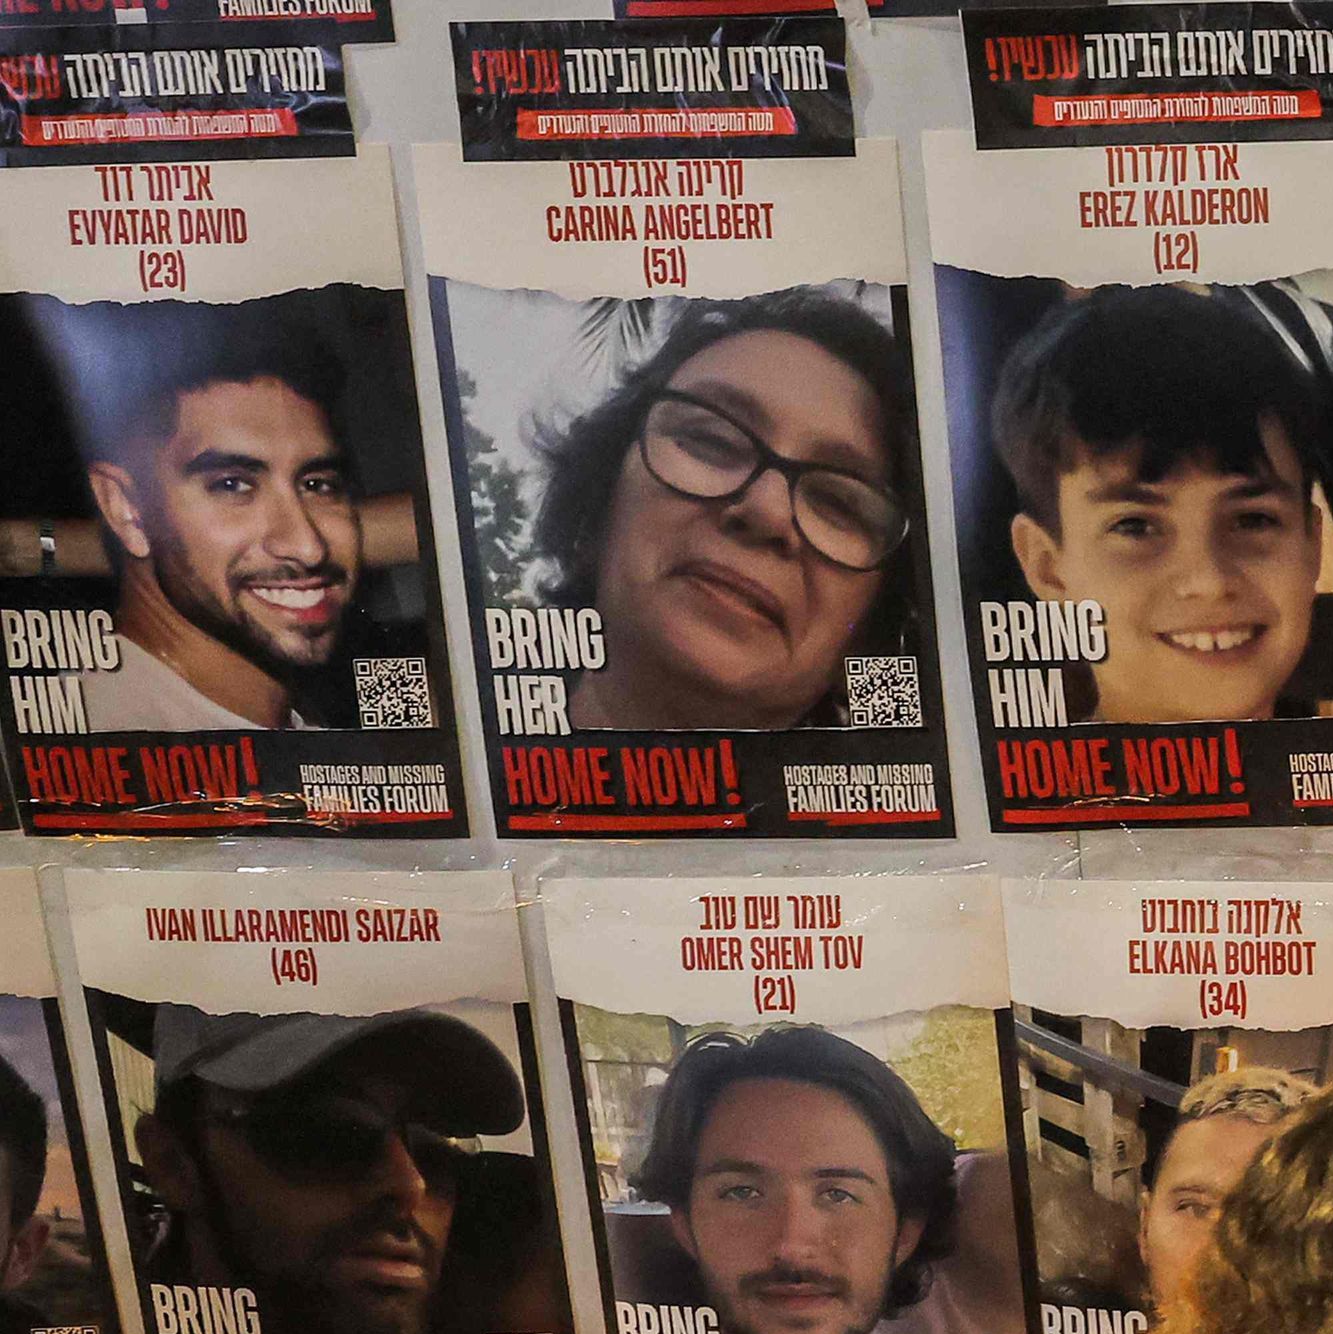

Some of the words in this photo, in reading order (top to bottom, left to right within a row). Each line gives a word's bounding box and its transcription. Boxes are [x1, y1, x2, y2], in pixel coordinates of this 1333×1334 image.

[986, 35, 1079, 81] עכשיו!
[1084, 32, 1172, 79] הביתה
[1177, 31, 1247, 76] אותם
[570, 160, 672, 198] אנגלברט
[676, 159, 744, 200] קרינה
[1105, 144, 1187, 187] קלדרון
[1196, 144, 1241, 181] ארז
[95, 166, 134, 202] דוד
[142, 164, 214, 202] אביתר
[547, 204, 637, 242] CARINA
[644, 203, 774, 241] ANGELBERT
[1080, 191, 1137, 228] EREZ
[1144, 187, 1269, 225] KALDERON
[69, 208, 173, 246] EVYATAR
[178, 208, 248, 245] DAVID
[140, 250, 186, 291] (23)
[643, 247, 687, 287] (51)
[1154, 231, 1199, 272] (12)
[485, 604, 605, 669] BRING
[494, 675, 571, 735] HER
[503, 747, 615, 805] HOME
[621, 739, 741, 805] NOW!
[147, 909, 196, 940] IVAN
[202, 908, 350, 943] ILLARAMENDI
[355, 907, 441, 943] SAIZAR
[700, 896, 736, 931] טוב
[744, 896, 780, 930] שם
[787, 896, 841, 929] עומר
[1143, 898, 1220, 934] בוחבוט
[1228, 898, 1302, 937] אלקנה
[272, 950, 318, 985] (46)
[682, 937, 744, 970] OMER
[752, 936, 814, 970] SHEM
[822, 936, 863, 970] TOV
[1129, 940, 1218, 974] ELKANA
[1225, 941, 1315, 976] BOHBOT
[754, 975, 796, 1012] (21)
[1201, 982, 1247, 1019] (34)
